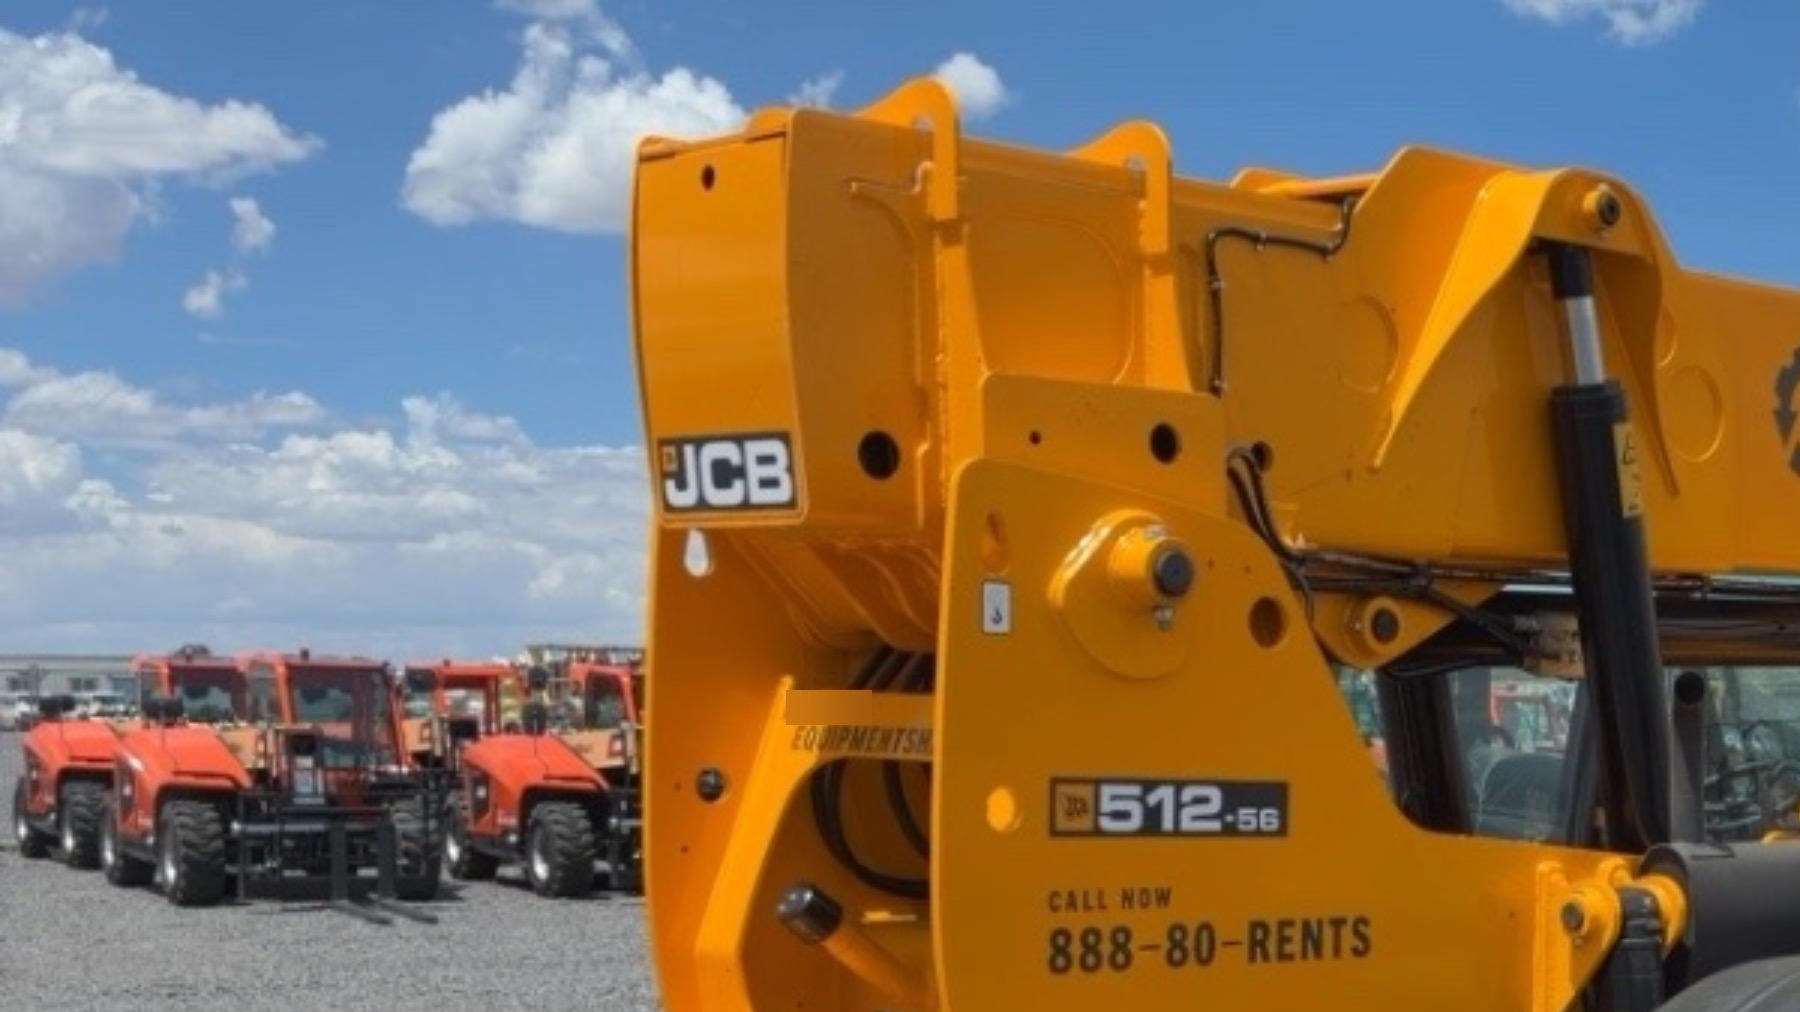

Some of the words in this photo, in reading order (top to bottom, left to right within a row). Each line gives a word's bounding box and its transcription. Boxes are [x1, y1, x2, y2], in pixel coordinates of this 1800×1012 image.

[664, 437, 794, 508] JCB
[1047, 889, 1109, 913] CALL
[1120, 886, 1172, 910] NOW
[1046, 914, 1372, 976] 888-80-RENTS
